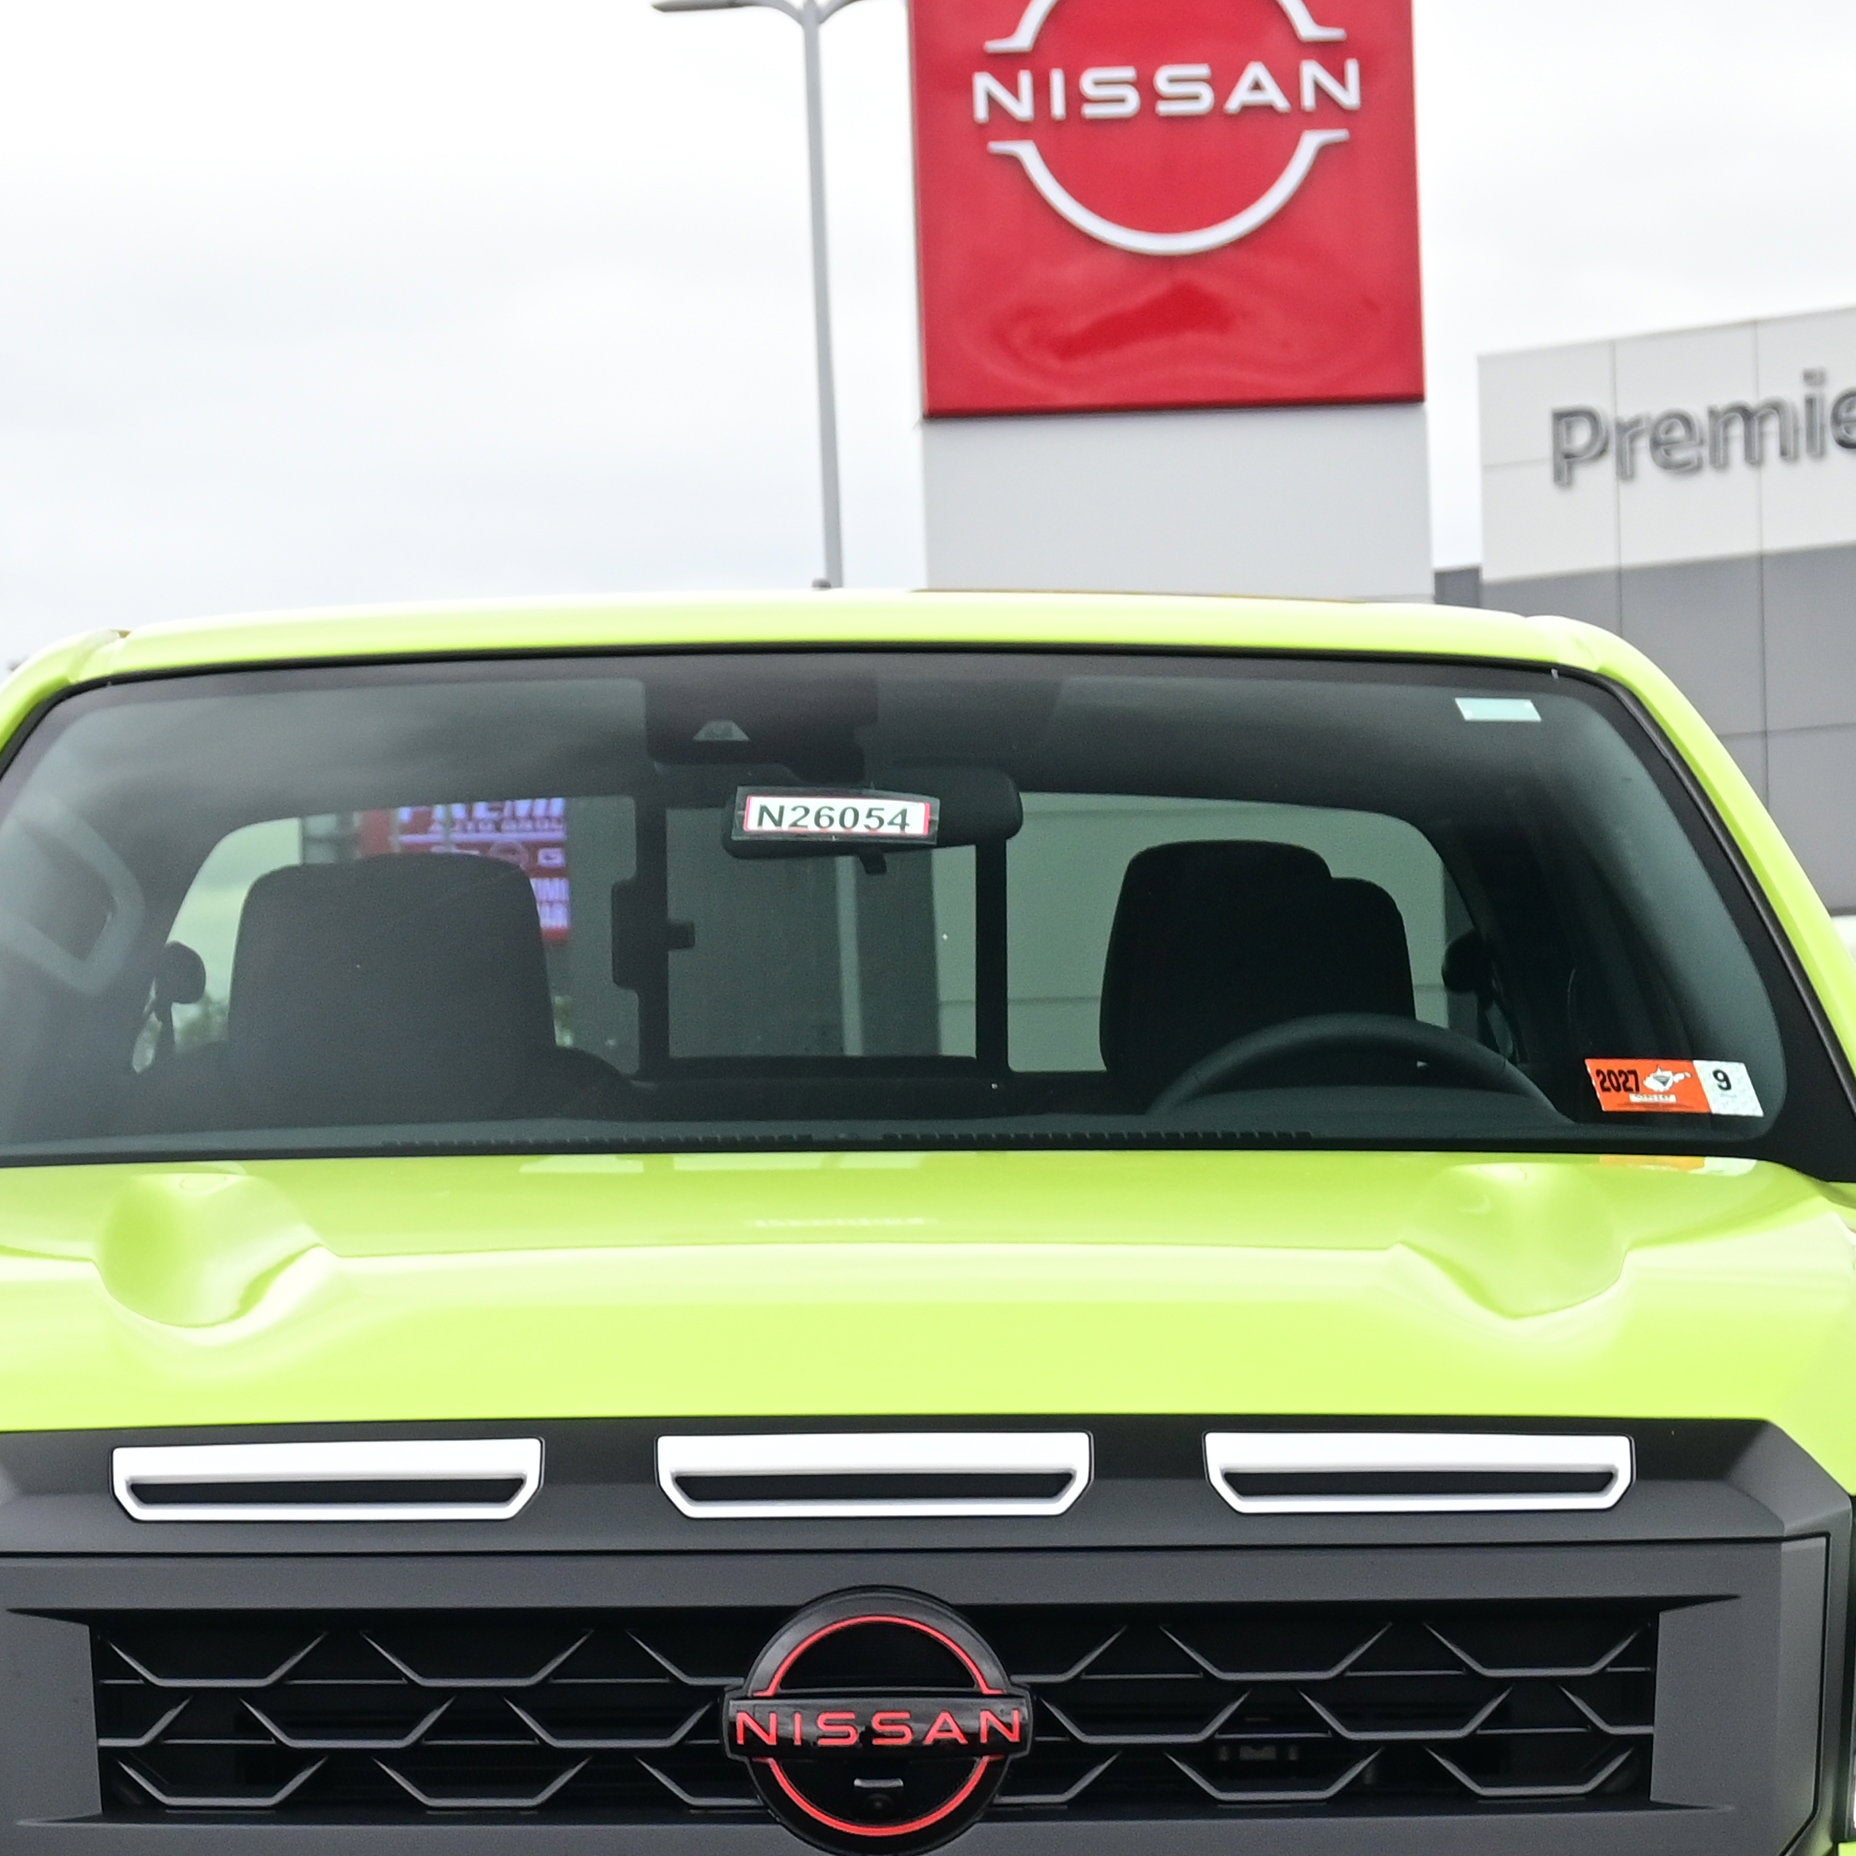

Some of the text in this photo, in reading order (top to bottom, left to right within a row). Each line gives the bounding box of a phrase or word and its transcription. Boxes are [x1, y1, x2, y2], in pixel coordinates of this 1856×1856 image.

[972, 58, 1361, 123] NISSAN
[756, 804, 910, 833] N26054
[1596, 1069, 1732, 1093] 2027 9
[736, 1709, 1021, 1746] NISSAN
